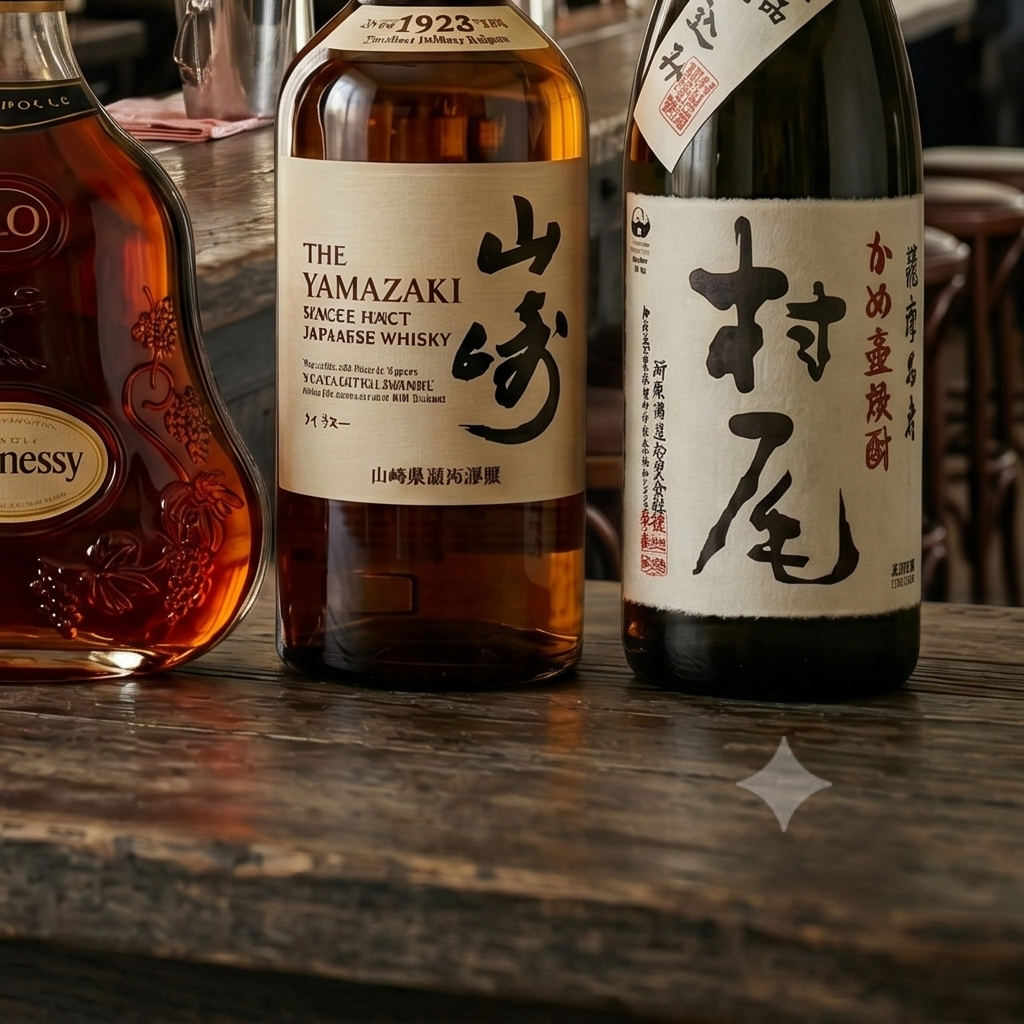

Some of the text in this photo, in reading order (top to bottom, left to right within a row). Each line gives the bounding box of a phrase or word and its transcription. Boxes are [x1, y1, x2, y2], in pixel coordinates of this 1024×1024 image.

[395, 13, 475, 34] 1923
[302, 242, 348, 266] THE
[302, 272, 462, 304] YAMAZAKI
[380, 331, 452, 347] WHISKY
